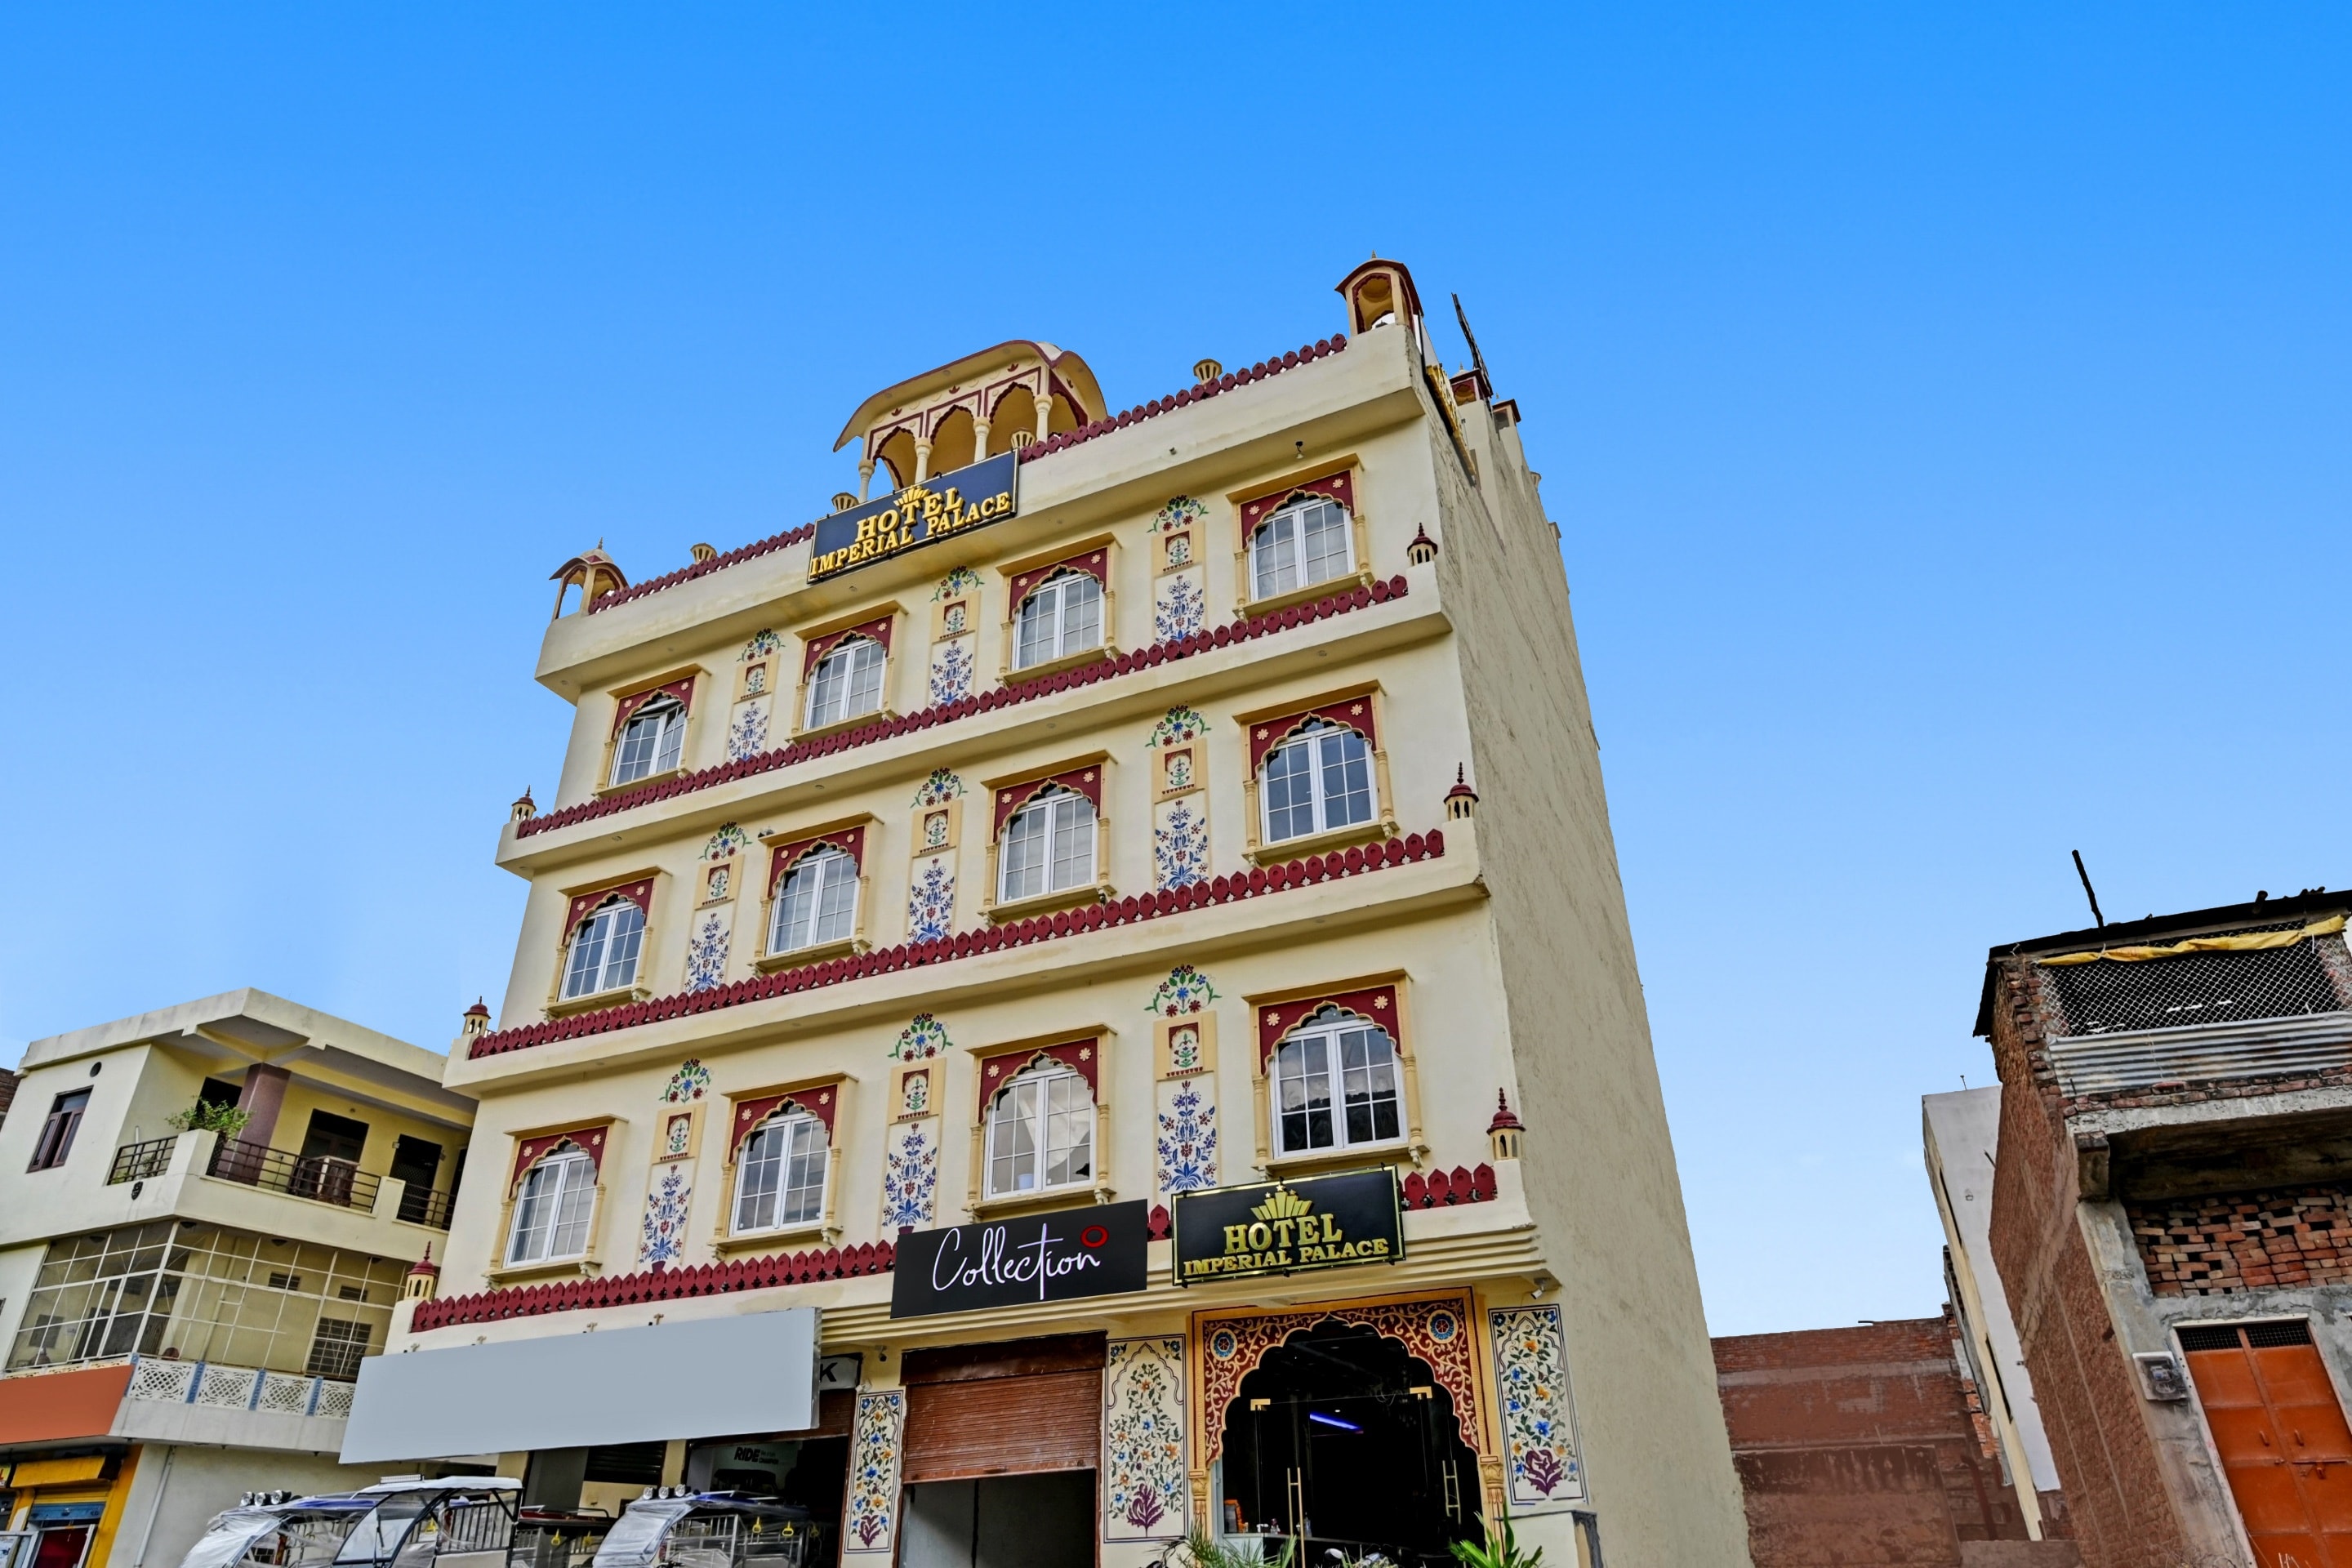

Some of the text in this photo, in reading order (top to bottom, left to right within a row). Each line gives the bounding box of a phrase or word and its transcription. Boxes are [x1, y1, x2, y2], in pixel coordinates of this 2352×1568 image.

[810, 492, 1012, 577] IMPERIAL PALACE
[855, 487, 965, 542] HOTEL
[1183, 1237, 1389, 1276] IMPERIAL PALACE
[1223, 1214, 1343, 1254] HOTEL
[933, 1223, 1101, 1300] Collection
[734, 1446, 760, 1463] RIDE
